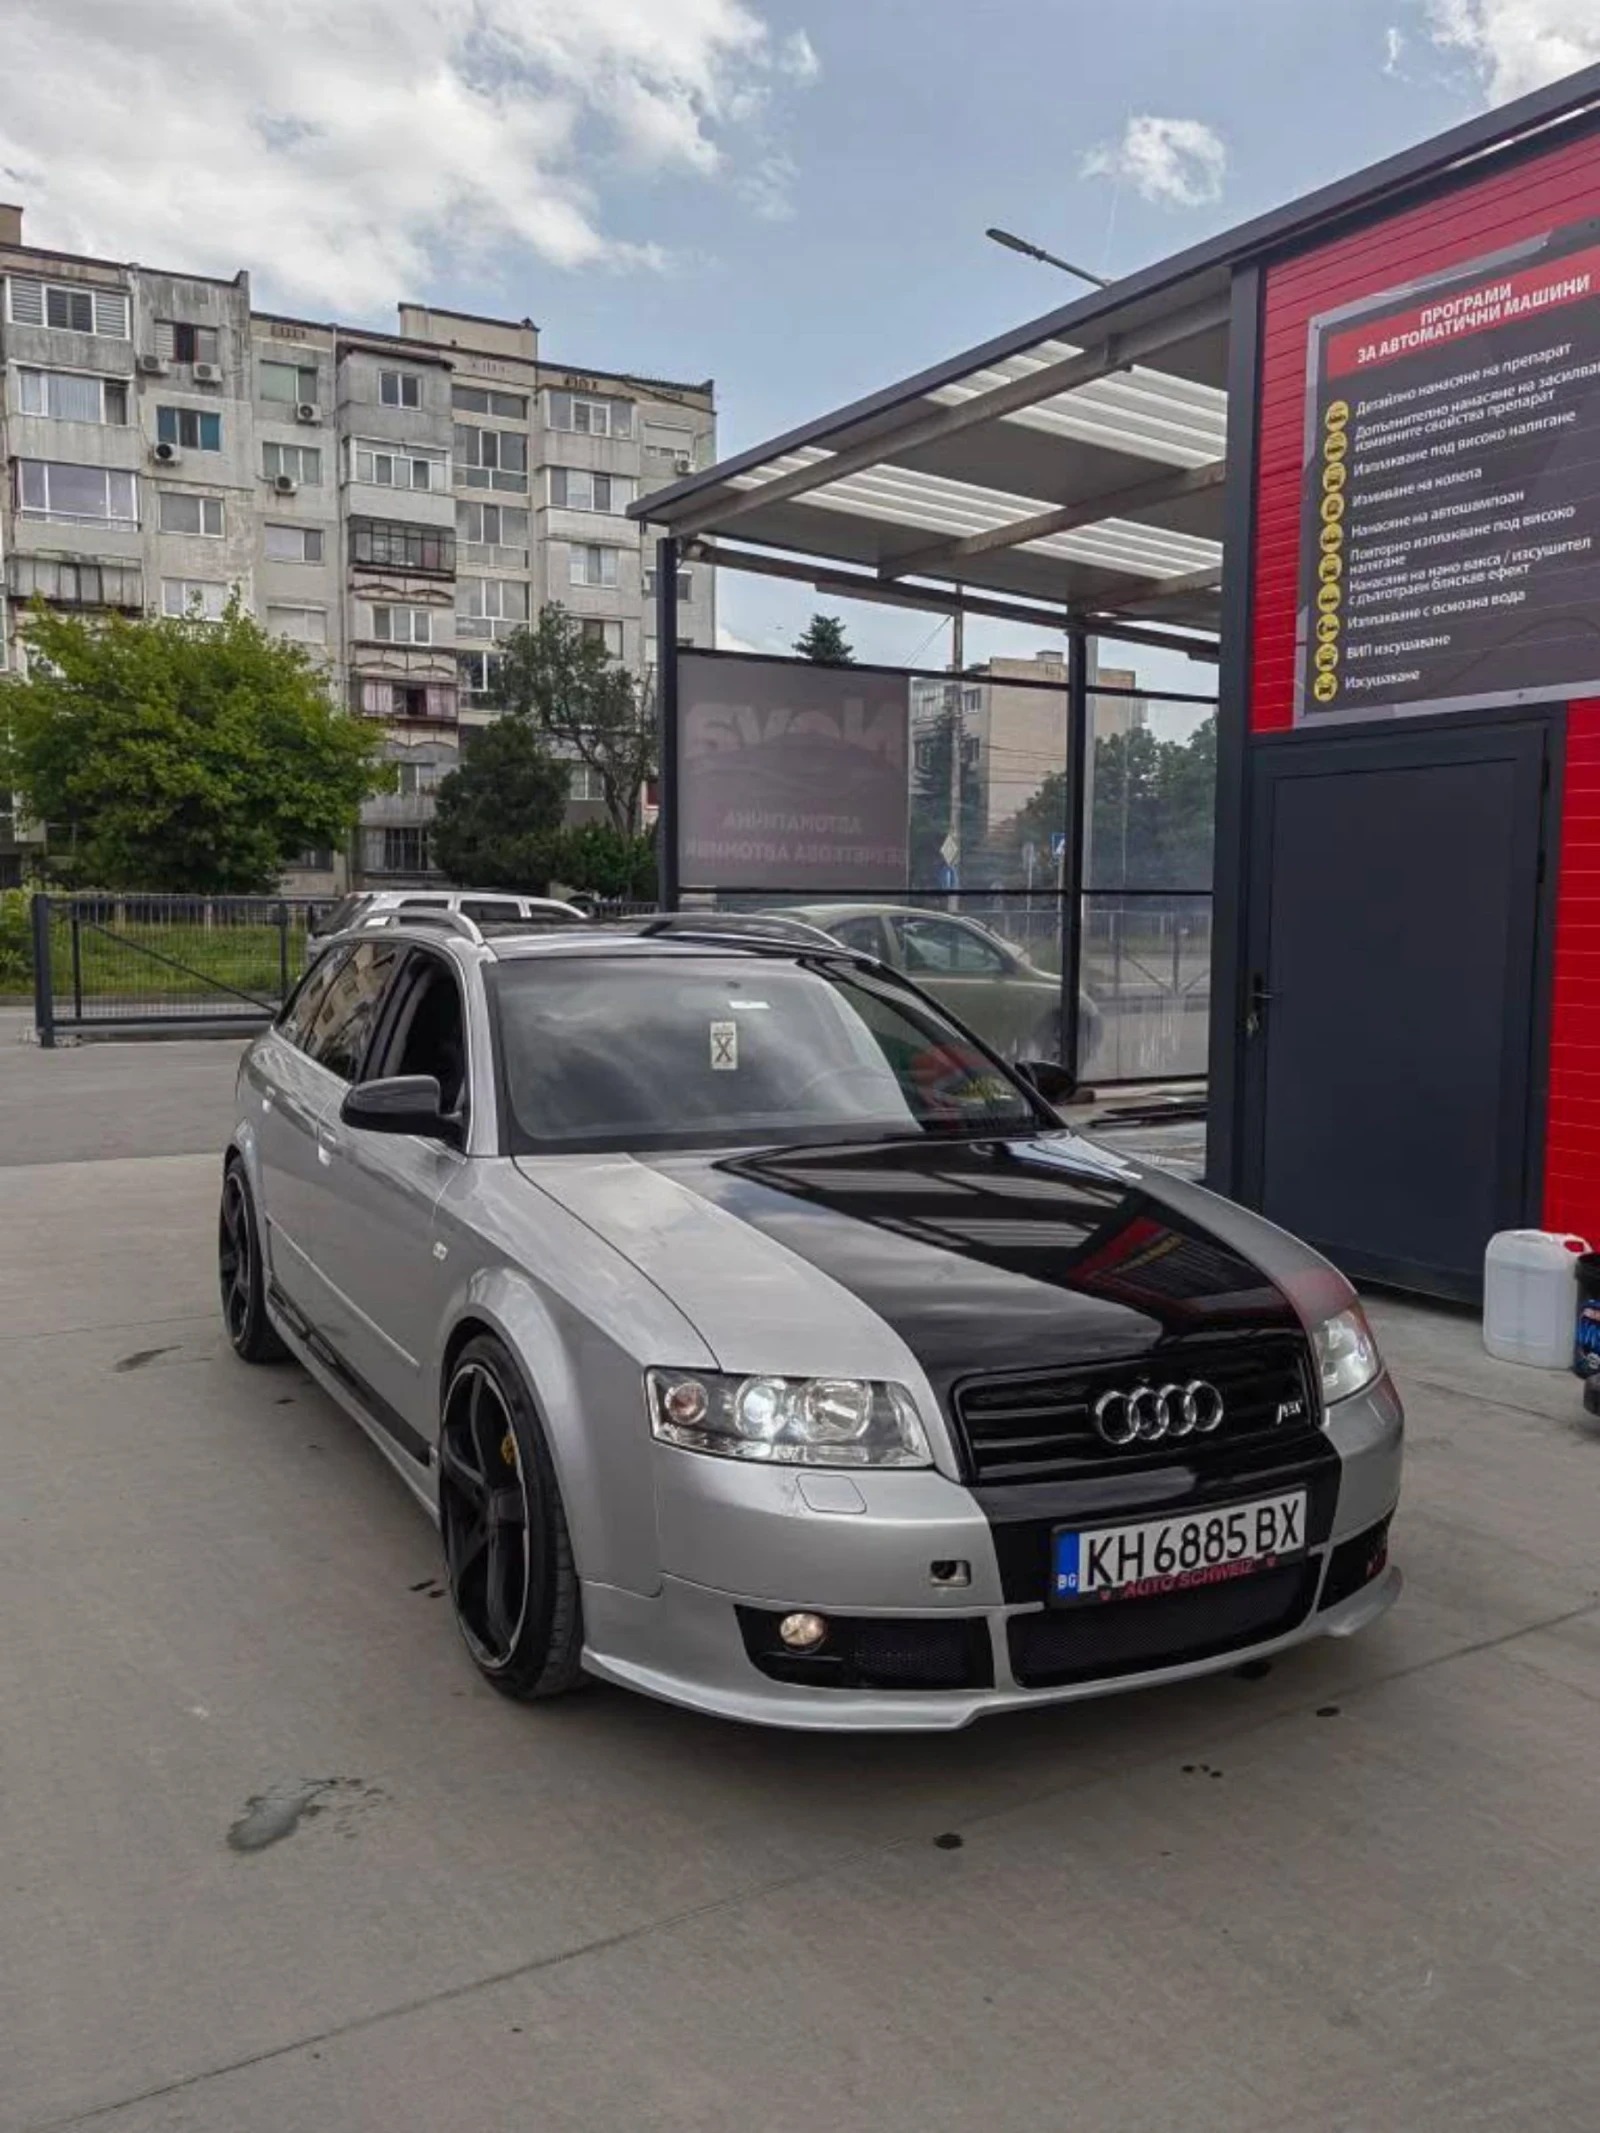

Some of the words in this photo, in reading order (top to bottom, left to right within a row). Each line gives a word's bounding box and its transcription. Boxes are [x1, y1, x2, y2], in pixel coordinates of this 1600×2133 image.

[1357, 345, 1377, 363] ЗА
[1379, 302, 1501, 357] АВТОМАТИЧНИ
[1504, 273, 1591, 317] МАШИНИ
[1420, 283, 1512, 327] ПРОГРАМИ
[1482, 364, 1499, 378] на
[1502, 343, 1571, 374] препарат
[1355, 405, 1449, 441] Допълнително
[1518, 381, 1535, 396] на
[1538, 361, 1600, 389] засилва
[1424, 408, 1484, 433] свойства
[1487, 389, 1555, 418] препарат
[1353, 449, 1428, 477] Изплакване
[1430, 441, 1455, 457] под
[1458, 428, 1507, 450] високо
[1508, 410, 1576, 436] налягане
[1352, 483, 1415, 507] Измиване
[1416, 480, 1432, 492] на
[1435, 467, 1482, 487] колела
[1350, 541, 1411, 561] Повторно
[1414, 524, 1491, 549] изплакване
[1493, 517, 1520, 532] под
[1522, 505, 1576, 526] високо
[1351, 516, 1411, 539] Нанасяне
[1412, 511, 1428, 523] на
[1431, 490, 1524, 520] автошампоан
[1349, 555, 1406, 575] налягане
[1410, 569, 1426, 581] на
[1428, 562, 1461, 578] нано
[1463, 554, 1501, 571] вакса
[1512, 537, 1591, 563] изсушител
[1348, 594, 1355, 605] с
[1487, 563, 1530, 581] ефект
[1347, 608, 1421, 629] Изплакване
[1422, 606, 1430, 617] с
[1432, 596, 1489, 615] осмозна
[1491, 590, 1526, 605] вода
[1346, 643, 1372, 659] ВИП
[1374, 635, 1451, 656] изсушаване
[1345, 670, 1420, 690] Изсушаване
[1086, 1532, 1145, 1587] KH
[1153, 1512, 1248, 1574] 6885
[1256, 1499, 1300, 1552] BX
[1057, 1573, 1077, 1590] BG
[1124, 1574, 1176, 1598] AUTO
[1176, 1559, 1255, 1588] SCHWEIZ
